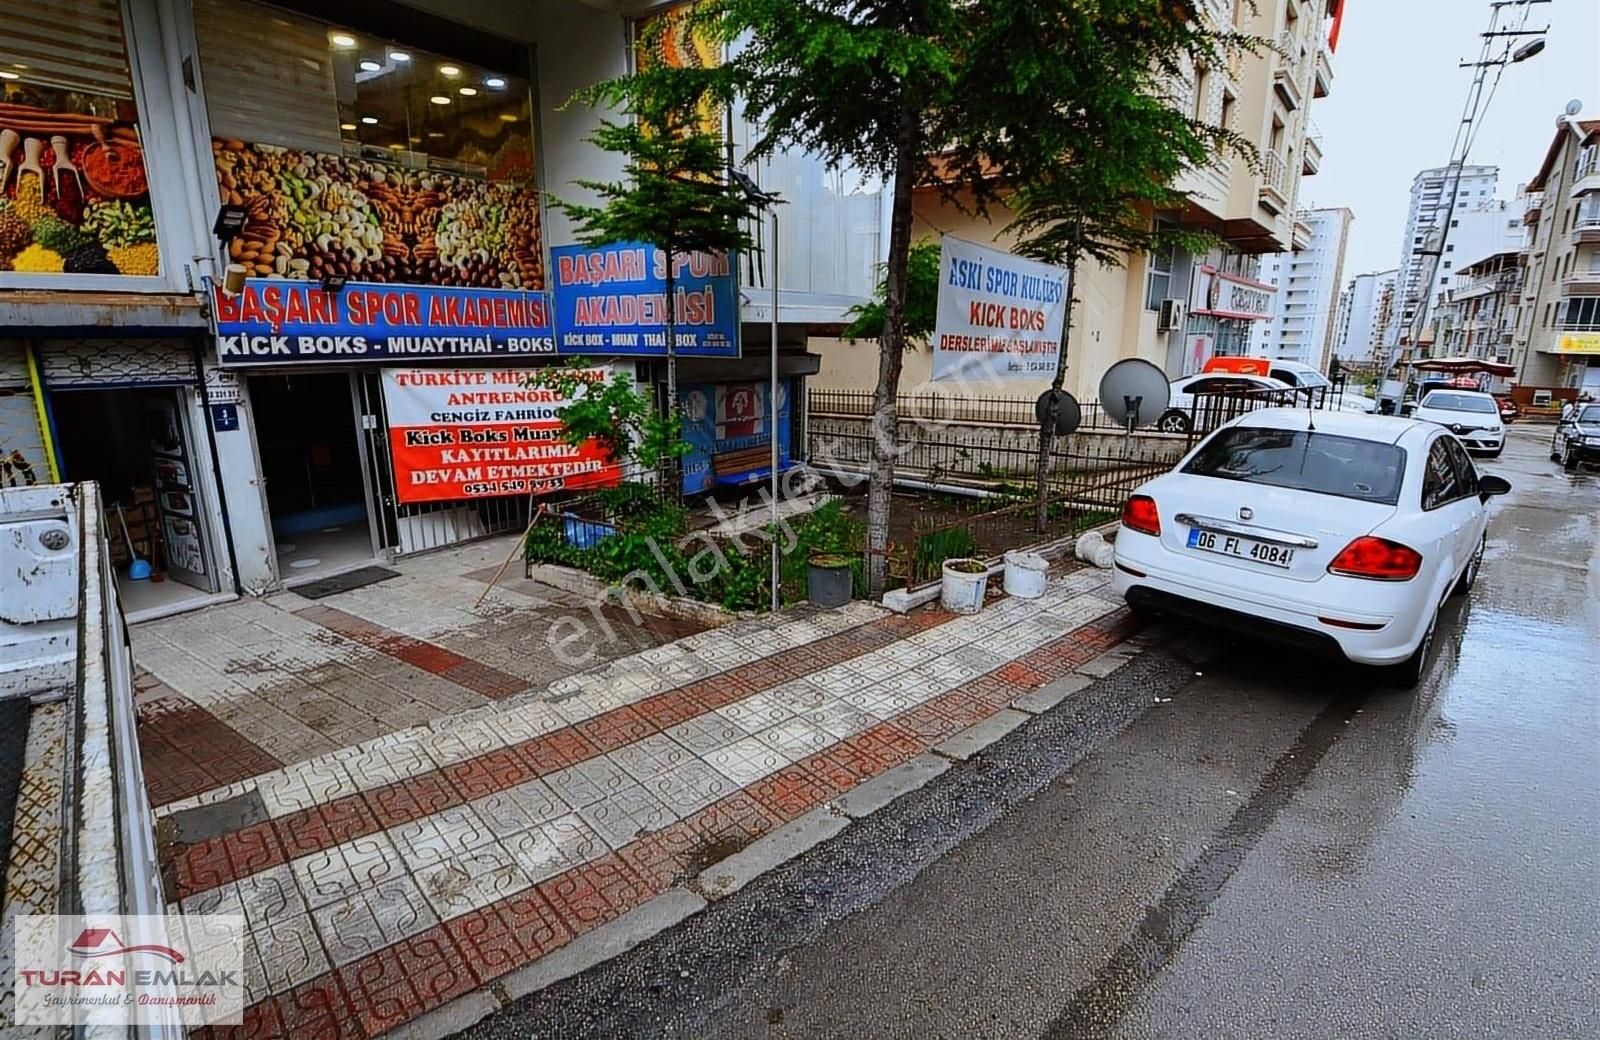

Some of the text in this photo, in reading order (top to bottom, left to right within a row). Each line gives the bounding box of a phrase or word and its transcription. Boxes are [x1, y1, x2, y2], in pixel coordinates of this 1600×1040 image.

[558, 247, 730, 287] BAŞARI SPOR
[986, 266, 1018, 297] SPOR
[213, 285, 549, 333] BAŞARI SPOR AKADEMİSİ
[574, 284, 715, 327] AKADEMİSİ
[970, 301, 1046, 332] KICK BOKS
[218, 332, 291, 355] KİCK
[298, 335, 367, 354] BOKS
[388, 333, 491, 353] MUAYTHAİ
[508, 337, 553, 352] BOKS
[564, 332, 584, 346] KİCK
[585, 333, 604, 346] BOX
[611, 333, 639, 346] MUAY
[643, 331, 666, 346] THAİ
[675, 333, 698, 347] BOX
[396, 370, 488, 387] TÜRKİYE
[430, 408, 491, 422] CENGİZ
[407, 429, 456, 447] Kick
[460, 425, 507, 443] Boks
[441, 445, 580, 464] KAYITLARIMIZ
[411, 466, 482, 485] DEVAM
[1198, 532, 1290, 565] 06 FL 4084
